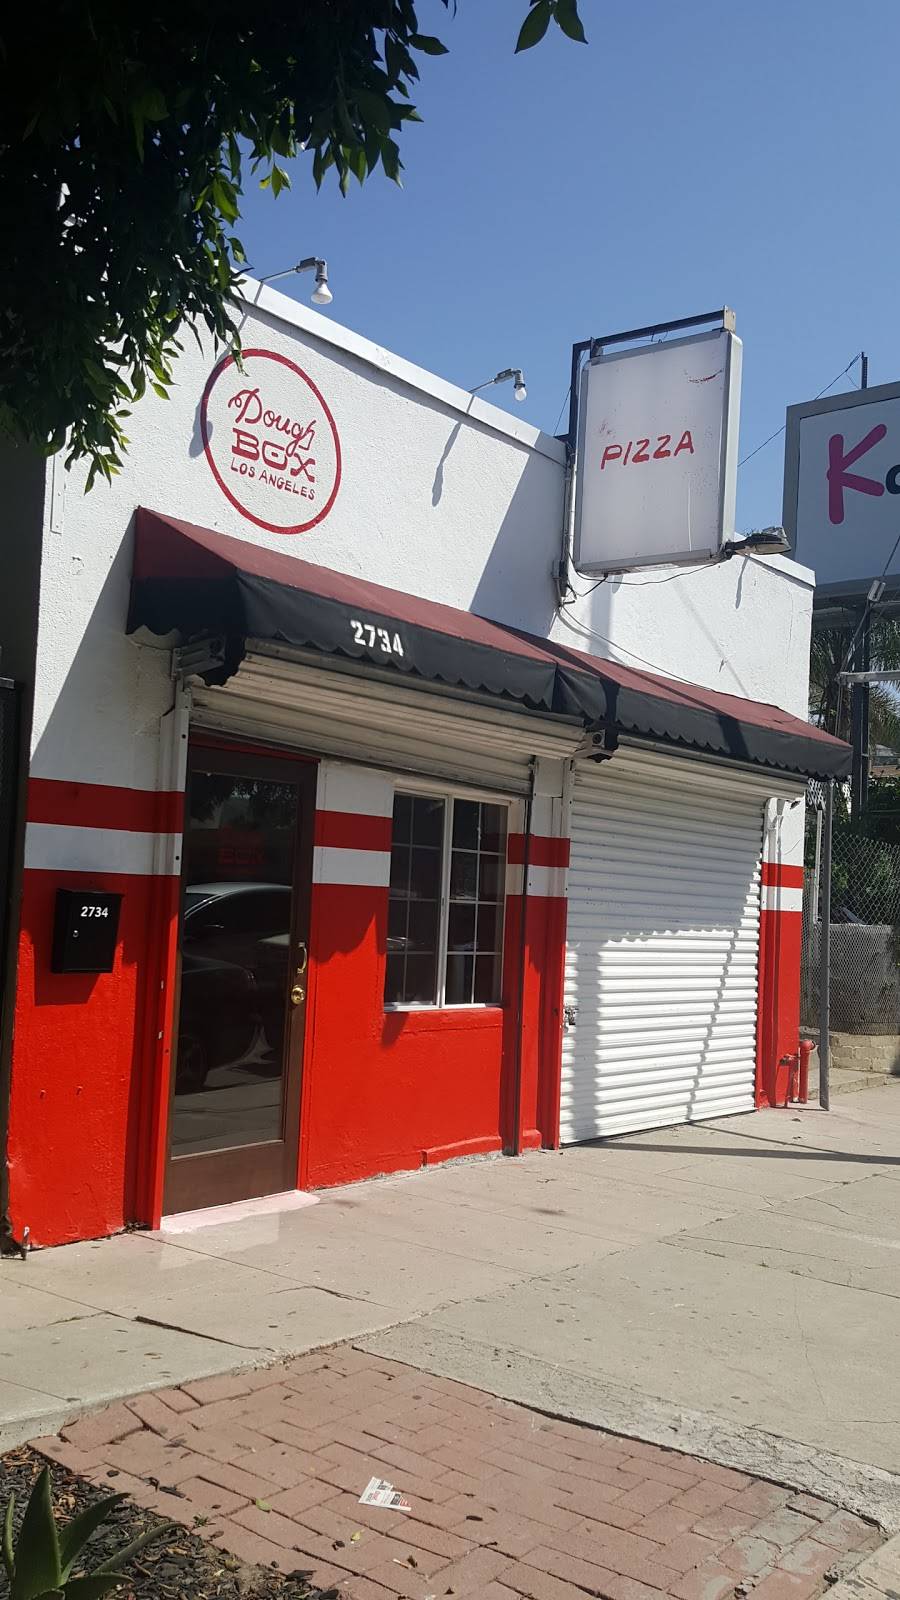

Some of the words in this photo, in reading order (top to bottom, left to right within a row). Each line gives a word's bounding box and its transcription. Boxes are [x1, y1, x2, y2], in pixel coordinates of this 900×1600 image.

[228, 388, 316, 457] Dough
[232, 428, 316, 483] BOX
[601, 430, 695, 470] PIZZA
[230, 457, 255, 478] LOS
[259, 470, 316, 500] ANGELES
[350, 620, 404, 657] 2734
[80, 906, 108, 918] 2734
